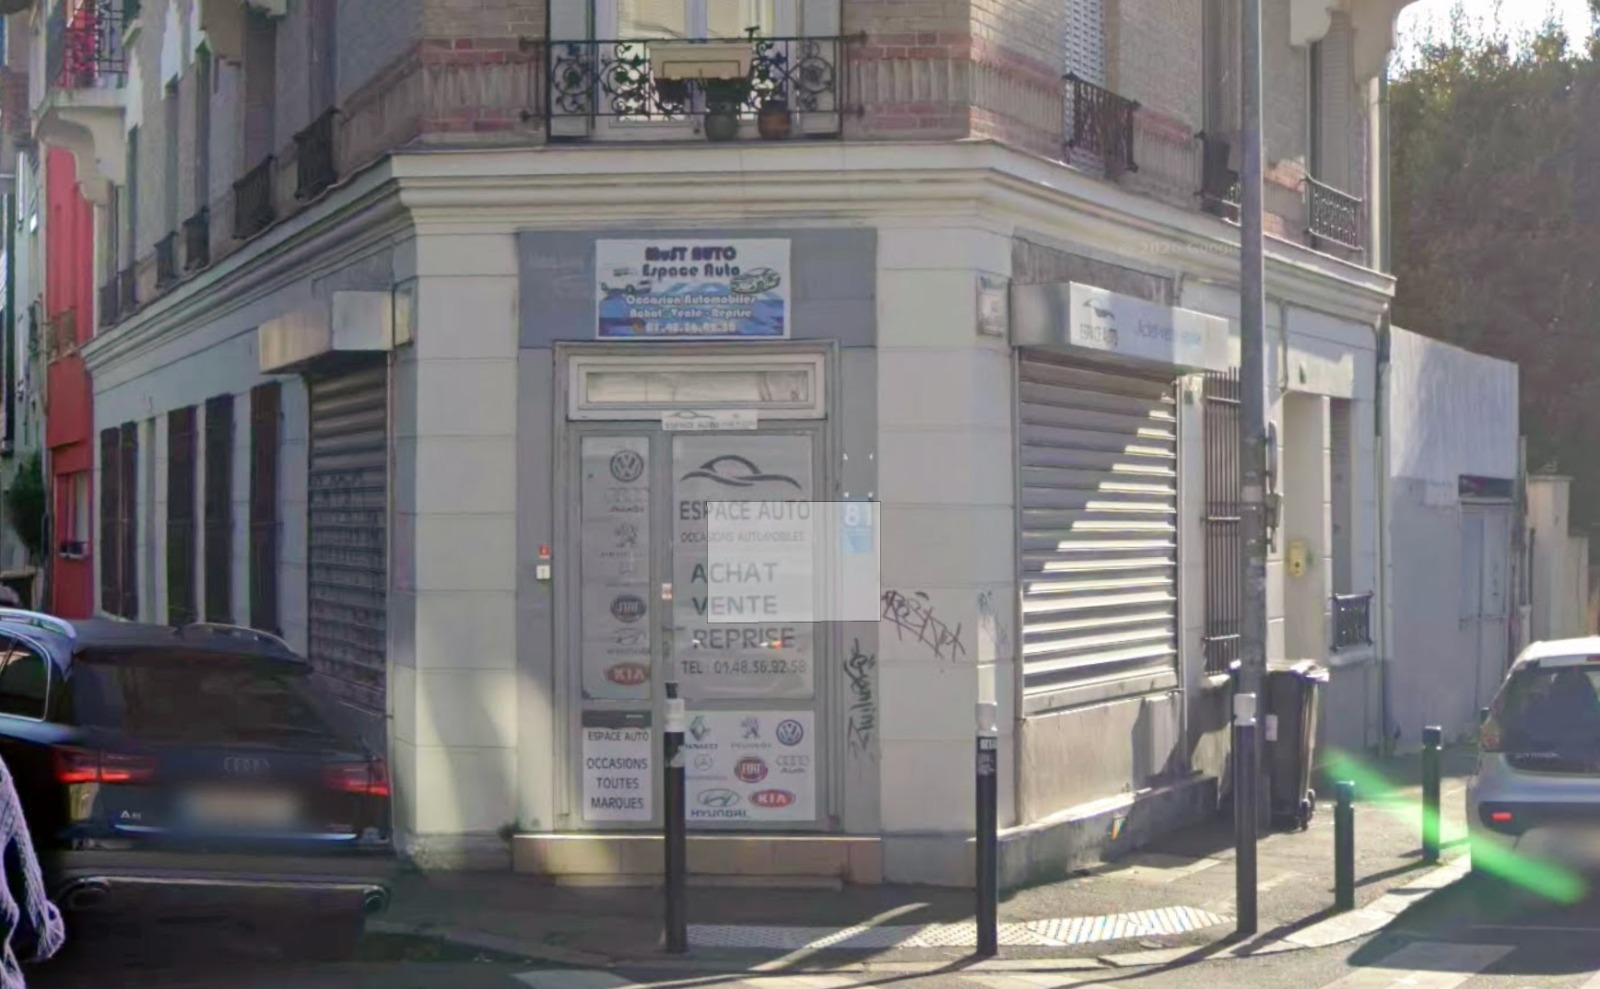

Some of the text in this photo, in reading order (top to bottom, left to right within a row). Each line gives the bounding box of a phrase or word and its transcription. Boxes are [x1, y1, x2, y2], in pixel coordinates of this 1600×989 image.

[642, 263, 699, 282] Espace
[680, 500, 811, 520] ESPACE AUTO
[681, 531, 806, 543] OCCASIONS AUTOMOBILES
[691, 563, 778, 584] ACHAT
[692, 595, 778, 616] VENTE
[692, 627, 795, 649] REPRISE
[614, 667, 645, 680] KIA
[681, 661, 703, 674] TEL
[588, 731, 649, 740] ESPACE AUTO
[587, 757, 648, 769] OCCASIONS
[597, 777, 639, 789] TOUTES
[591, 797, 644, 809] MARQUES
[758, 793, 788, 804] KIA
